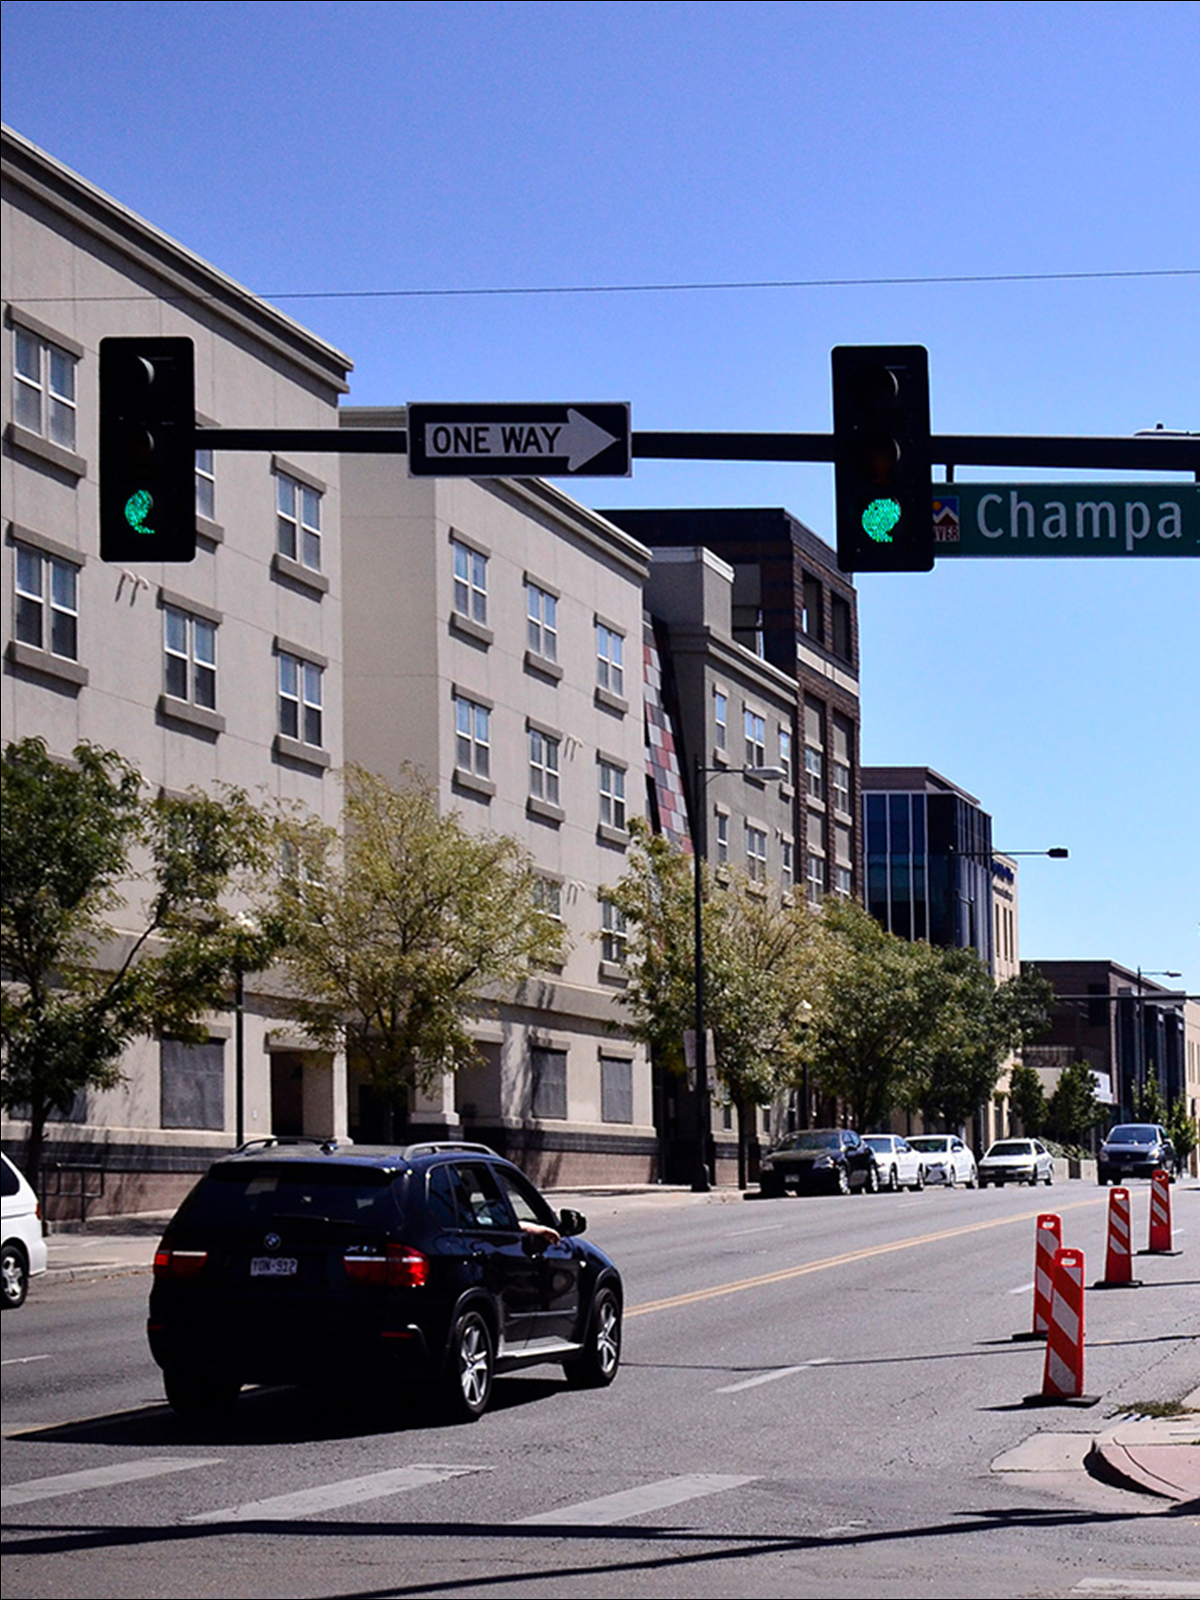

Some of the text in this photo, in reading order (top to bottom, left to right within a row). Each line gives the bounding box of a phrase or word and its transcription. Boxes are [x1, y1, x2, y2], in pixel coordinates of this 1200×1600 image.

[432, 426, 562, 453] ONE WAY
[977, 491, 1182, 551] Champa
